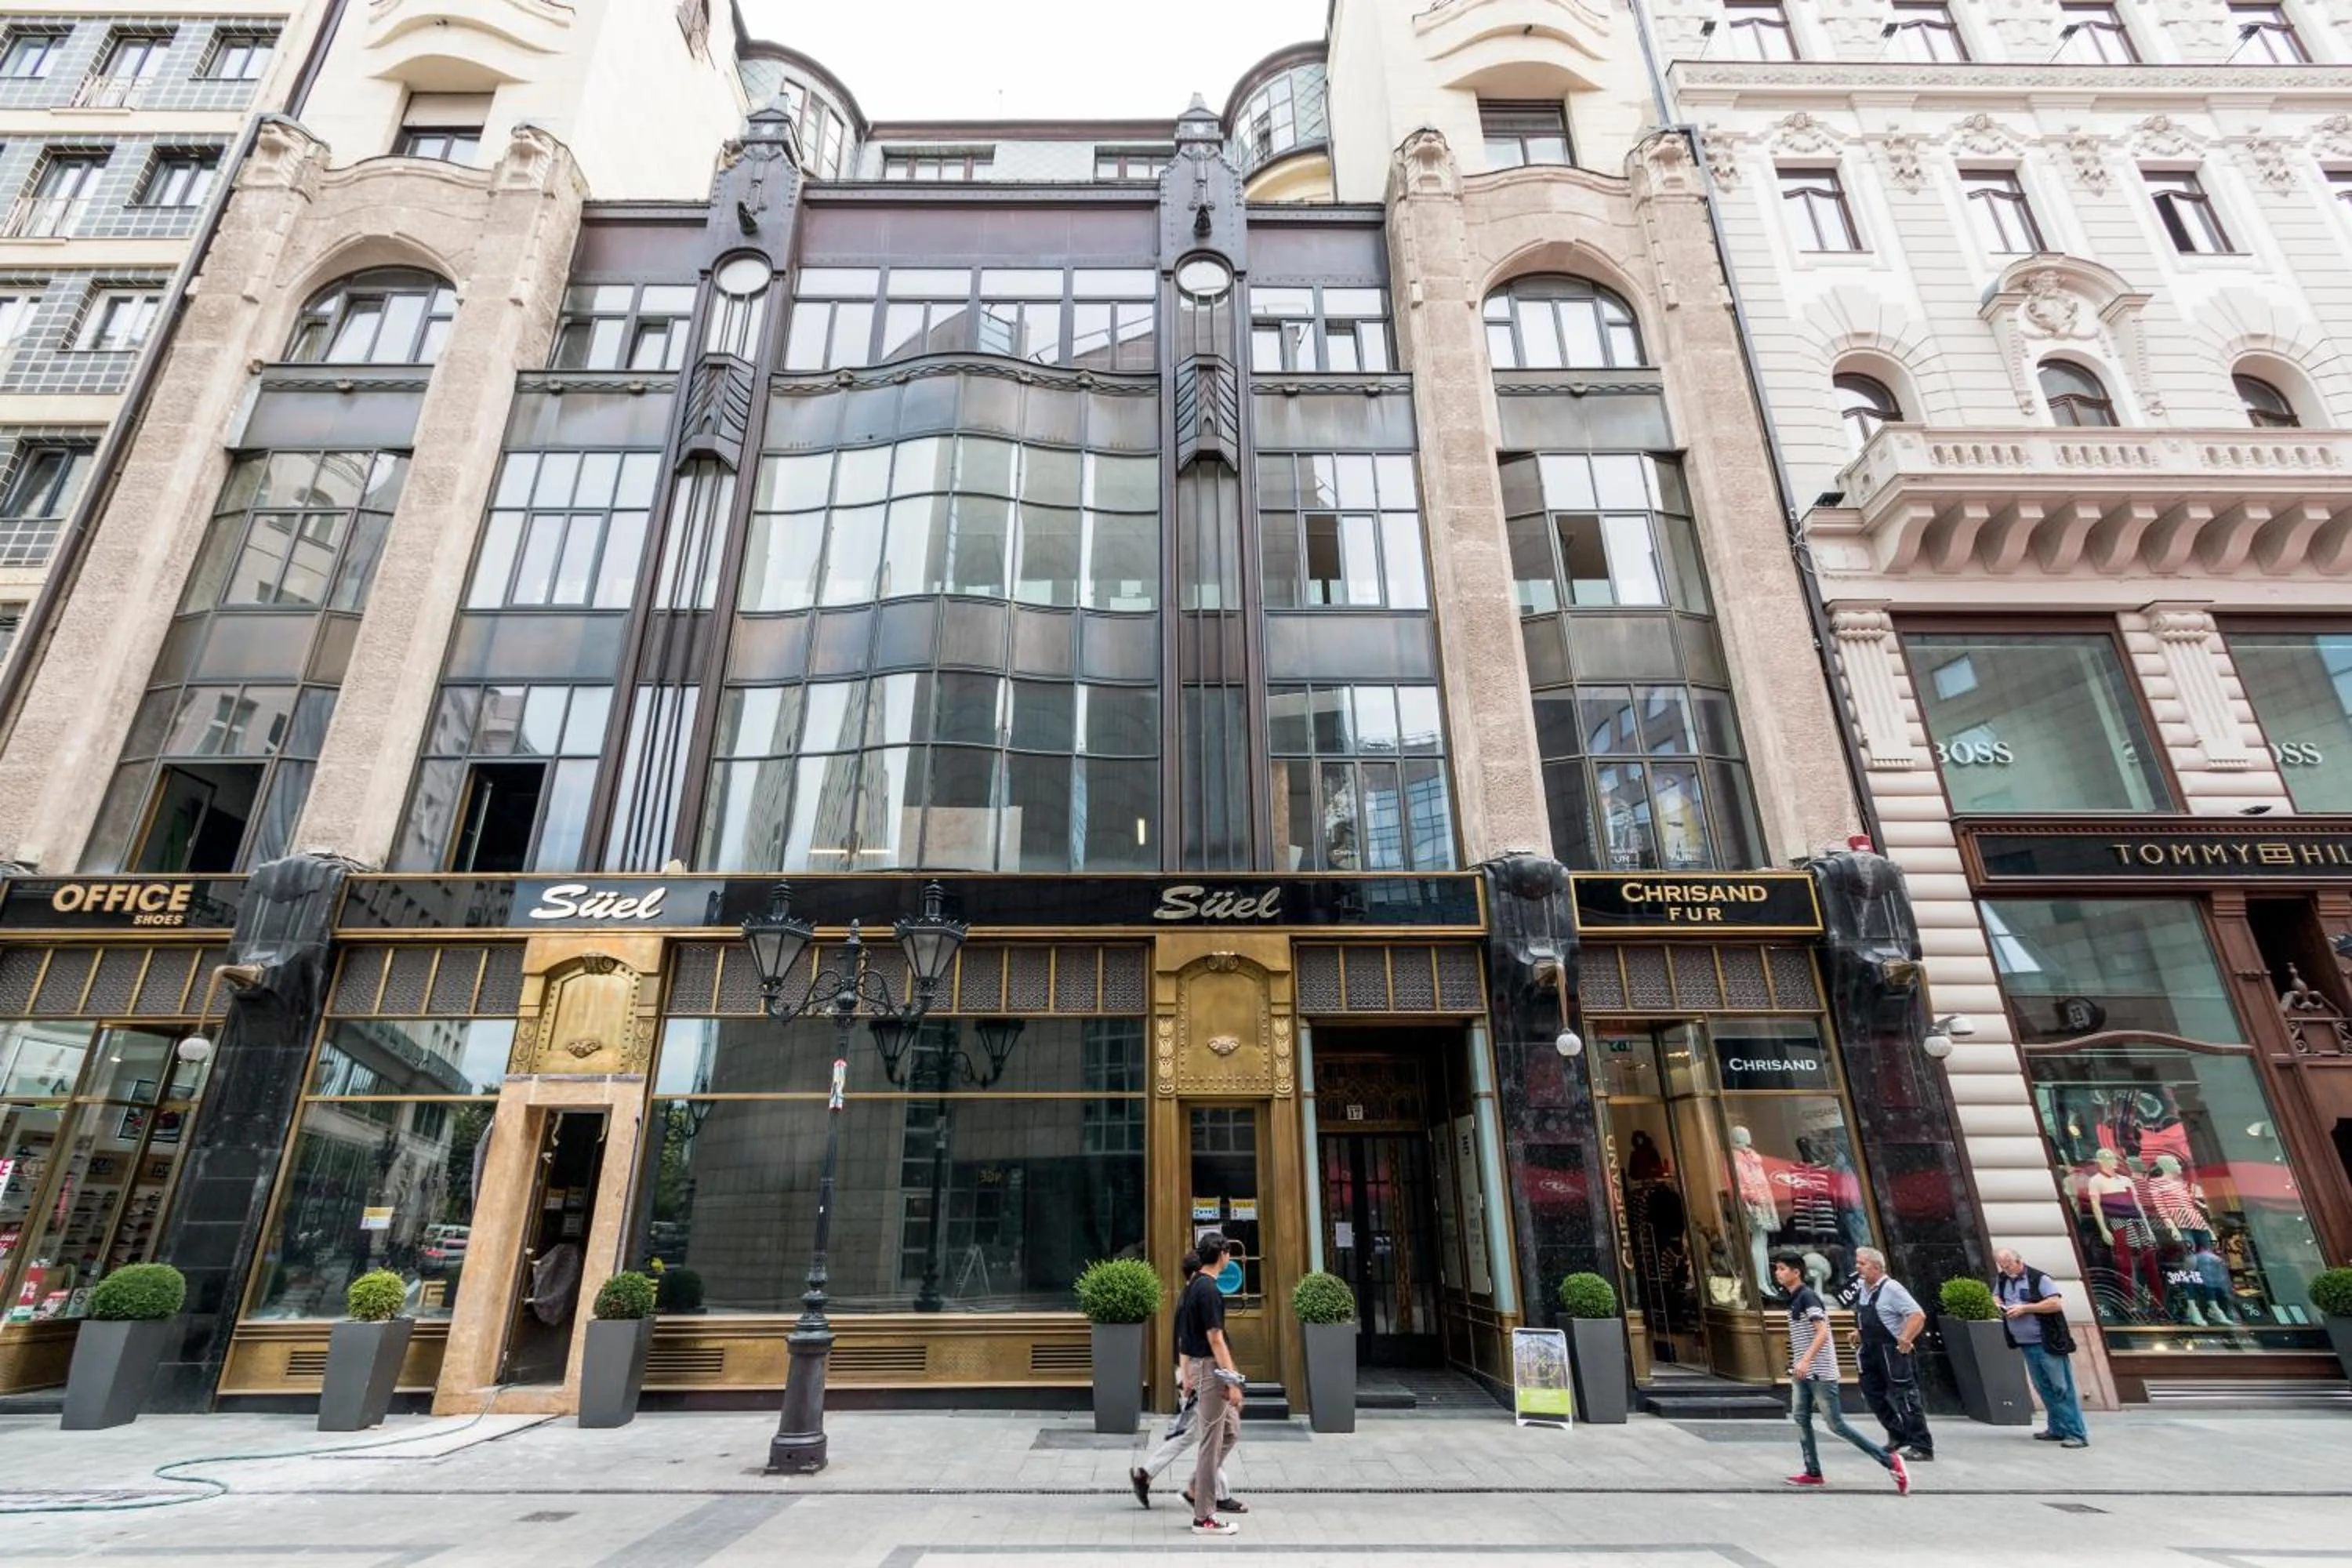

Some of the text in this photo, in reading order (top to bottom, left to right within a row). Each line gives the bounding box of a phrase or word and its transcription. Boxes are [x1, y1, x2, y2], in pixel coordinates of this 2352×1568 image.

[2112, 843, 2249, 864] TOMMY
[53, 884, 193, 912] OFFICE
[529, 884, 666, 920] Süel
[1153, 884, 1283, 920] Süel
[1621, 882, 1768, 902] CHRISAND
[132, 914, 184, 925] SHOES
[1669, 907, 1722, 921] FUR
